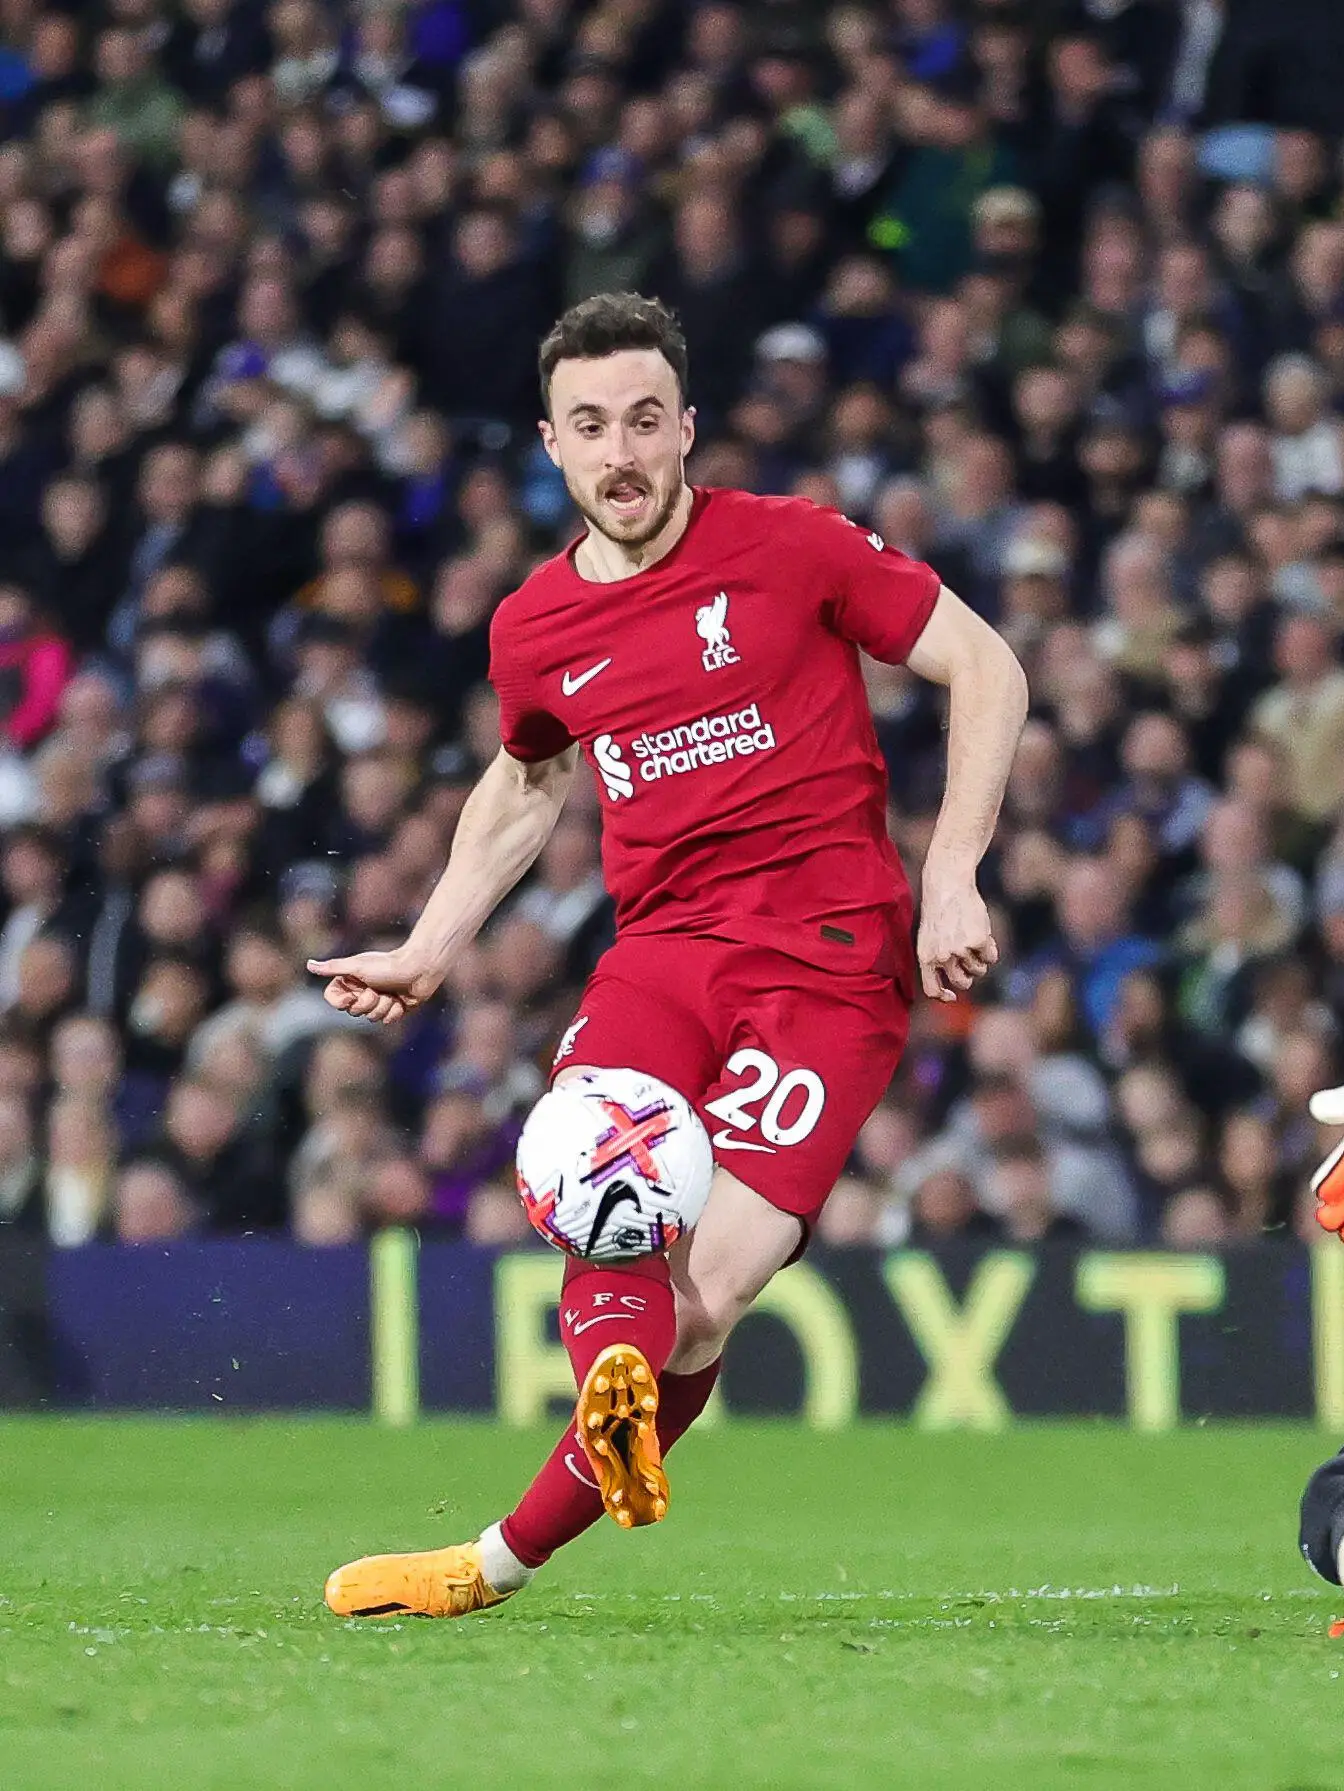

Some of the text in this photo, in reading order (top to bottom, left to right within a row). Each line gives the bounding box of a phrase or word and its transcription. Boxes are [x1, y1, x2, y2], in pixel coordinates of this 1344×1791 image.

[631, 703, 762, 758] standard
[640, 723, 776, 782] chartered
[704, 1048, 825, 1147] 20
